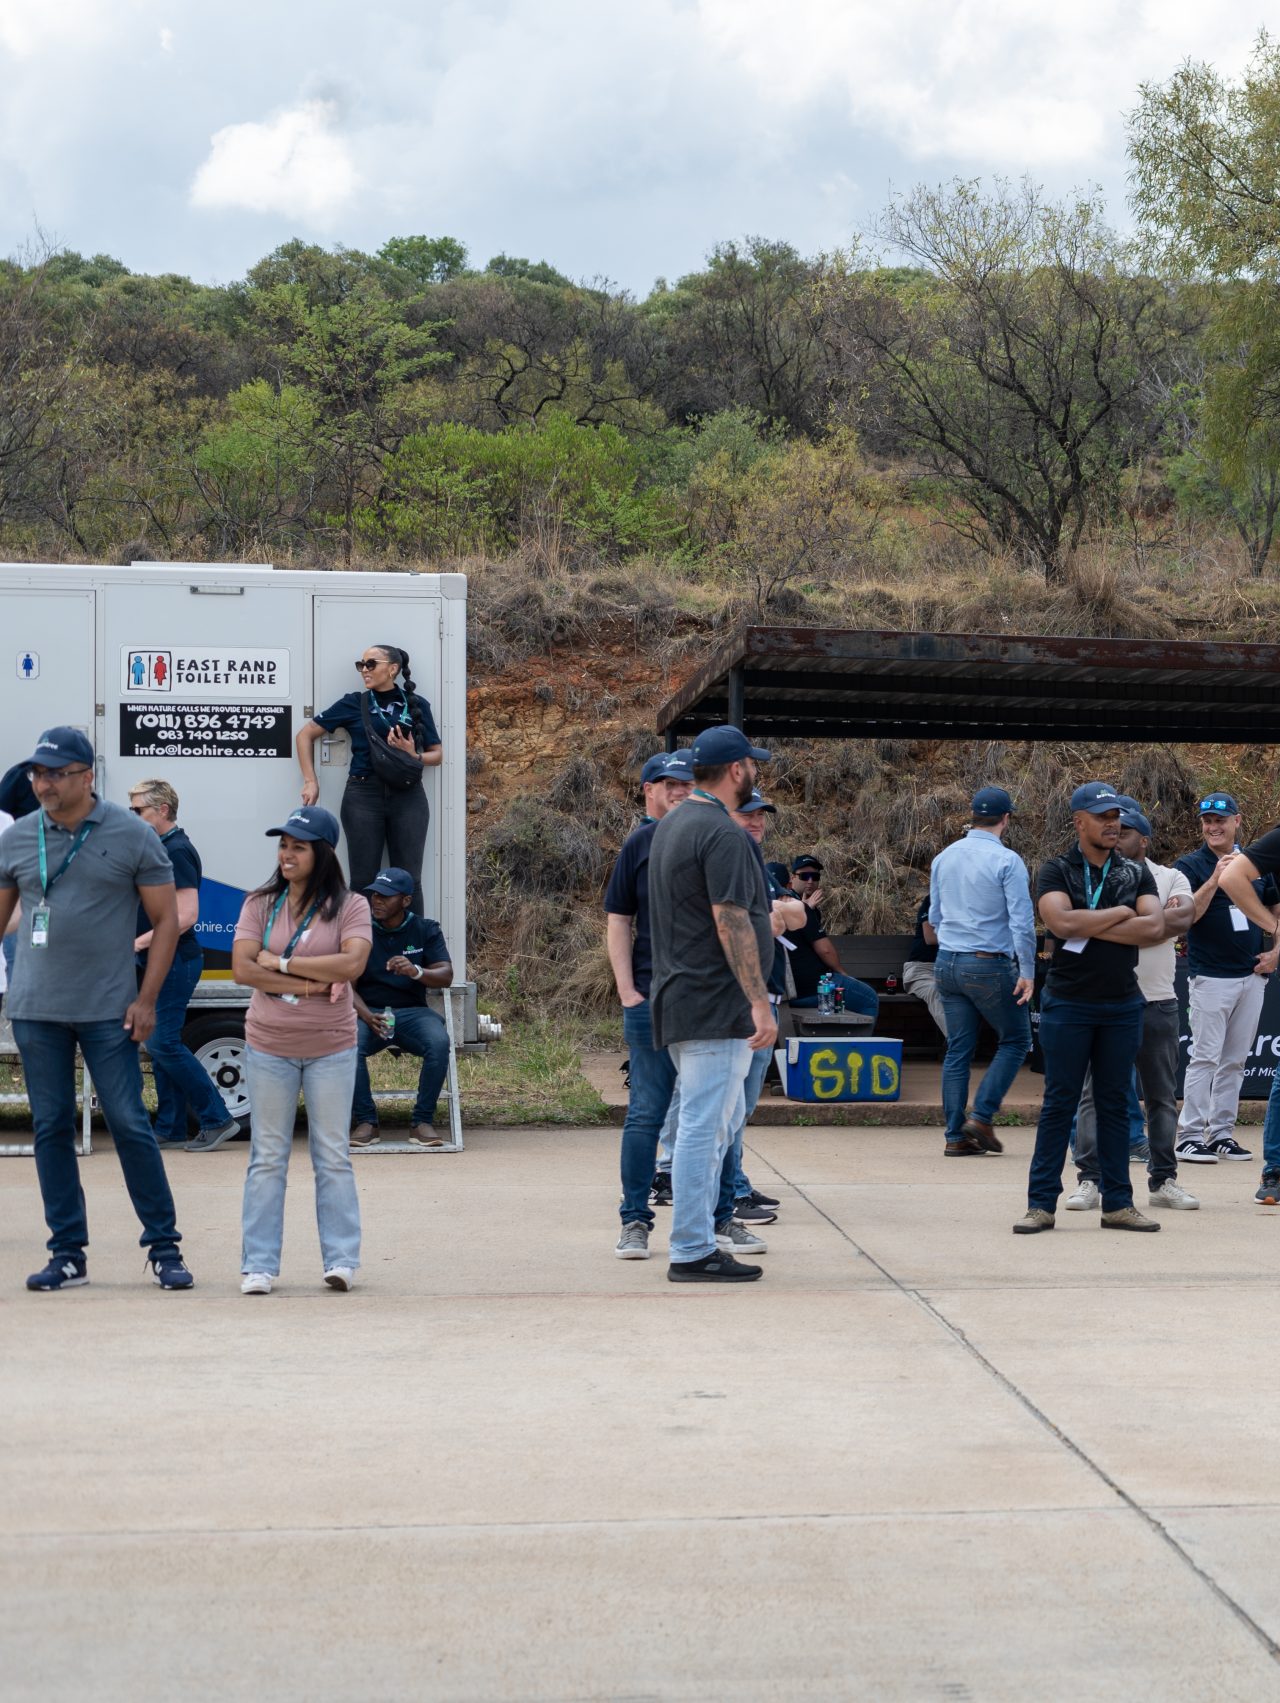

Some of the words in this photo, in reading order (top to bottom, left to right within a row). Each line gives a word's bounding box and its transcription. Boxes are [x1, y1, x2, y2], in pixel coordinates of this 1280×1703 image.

[176, 659, 220, 671] EAST
[227, 660, 277, 672] RAND
[176, 672, 231, 684] TOILET
[238, 673, 276, 684] HIRE
[127, 704, 147, 712] WHEN
[242, 706, 255, 714] THE
[255, 706, 285, 714] ANSWER
[136, 713, 181, 730] (011)
[184, 714, 222, 729] 896
[225, 714, 276, 729] 4749
[157, 730, 184, 740] 083
[186, 730, 213, 740] 740
[134, 743, 278, 756] info@loohire.co.za
